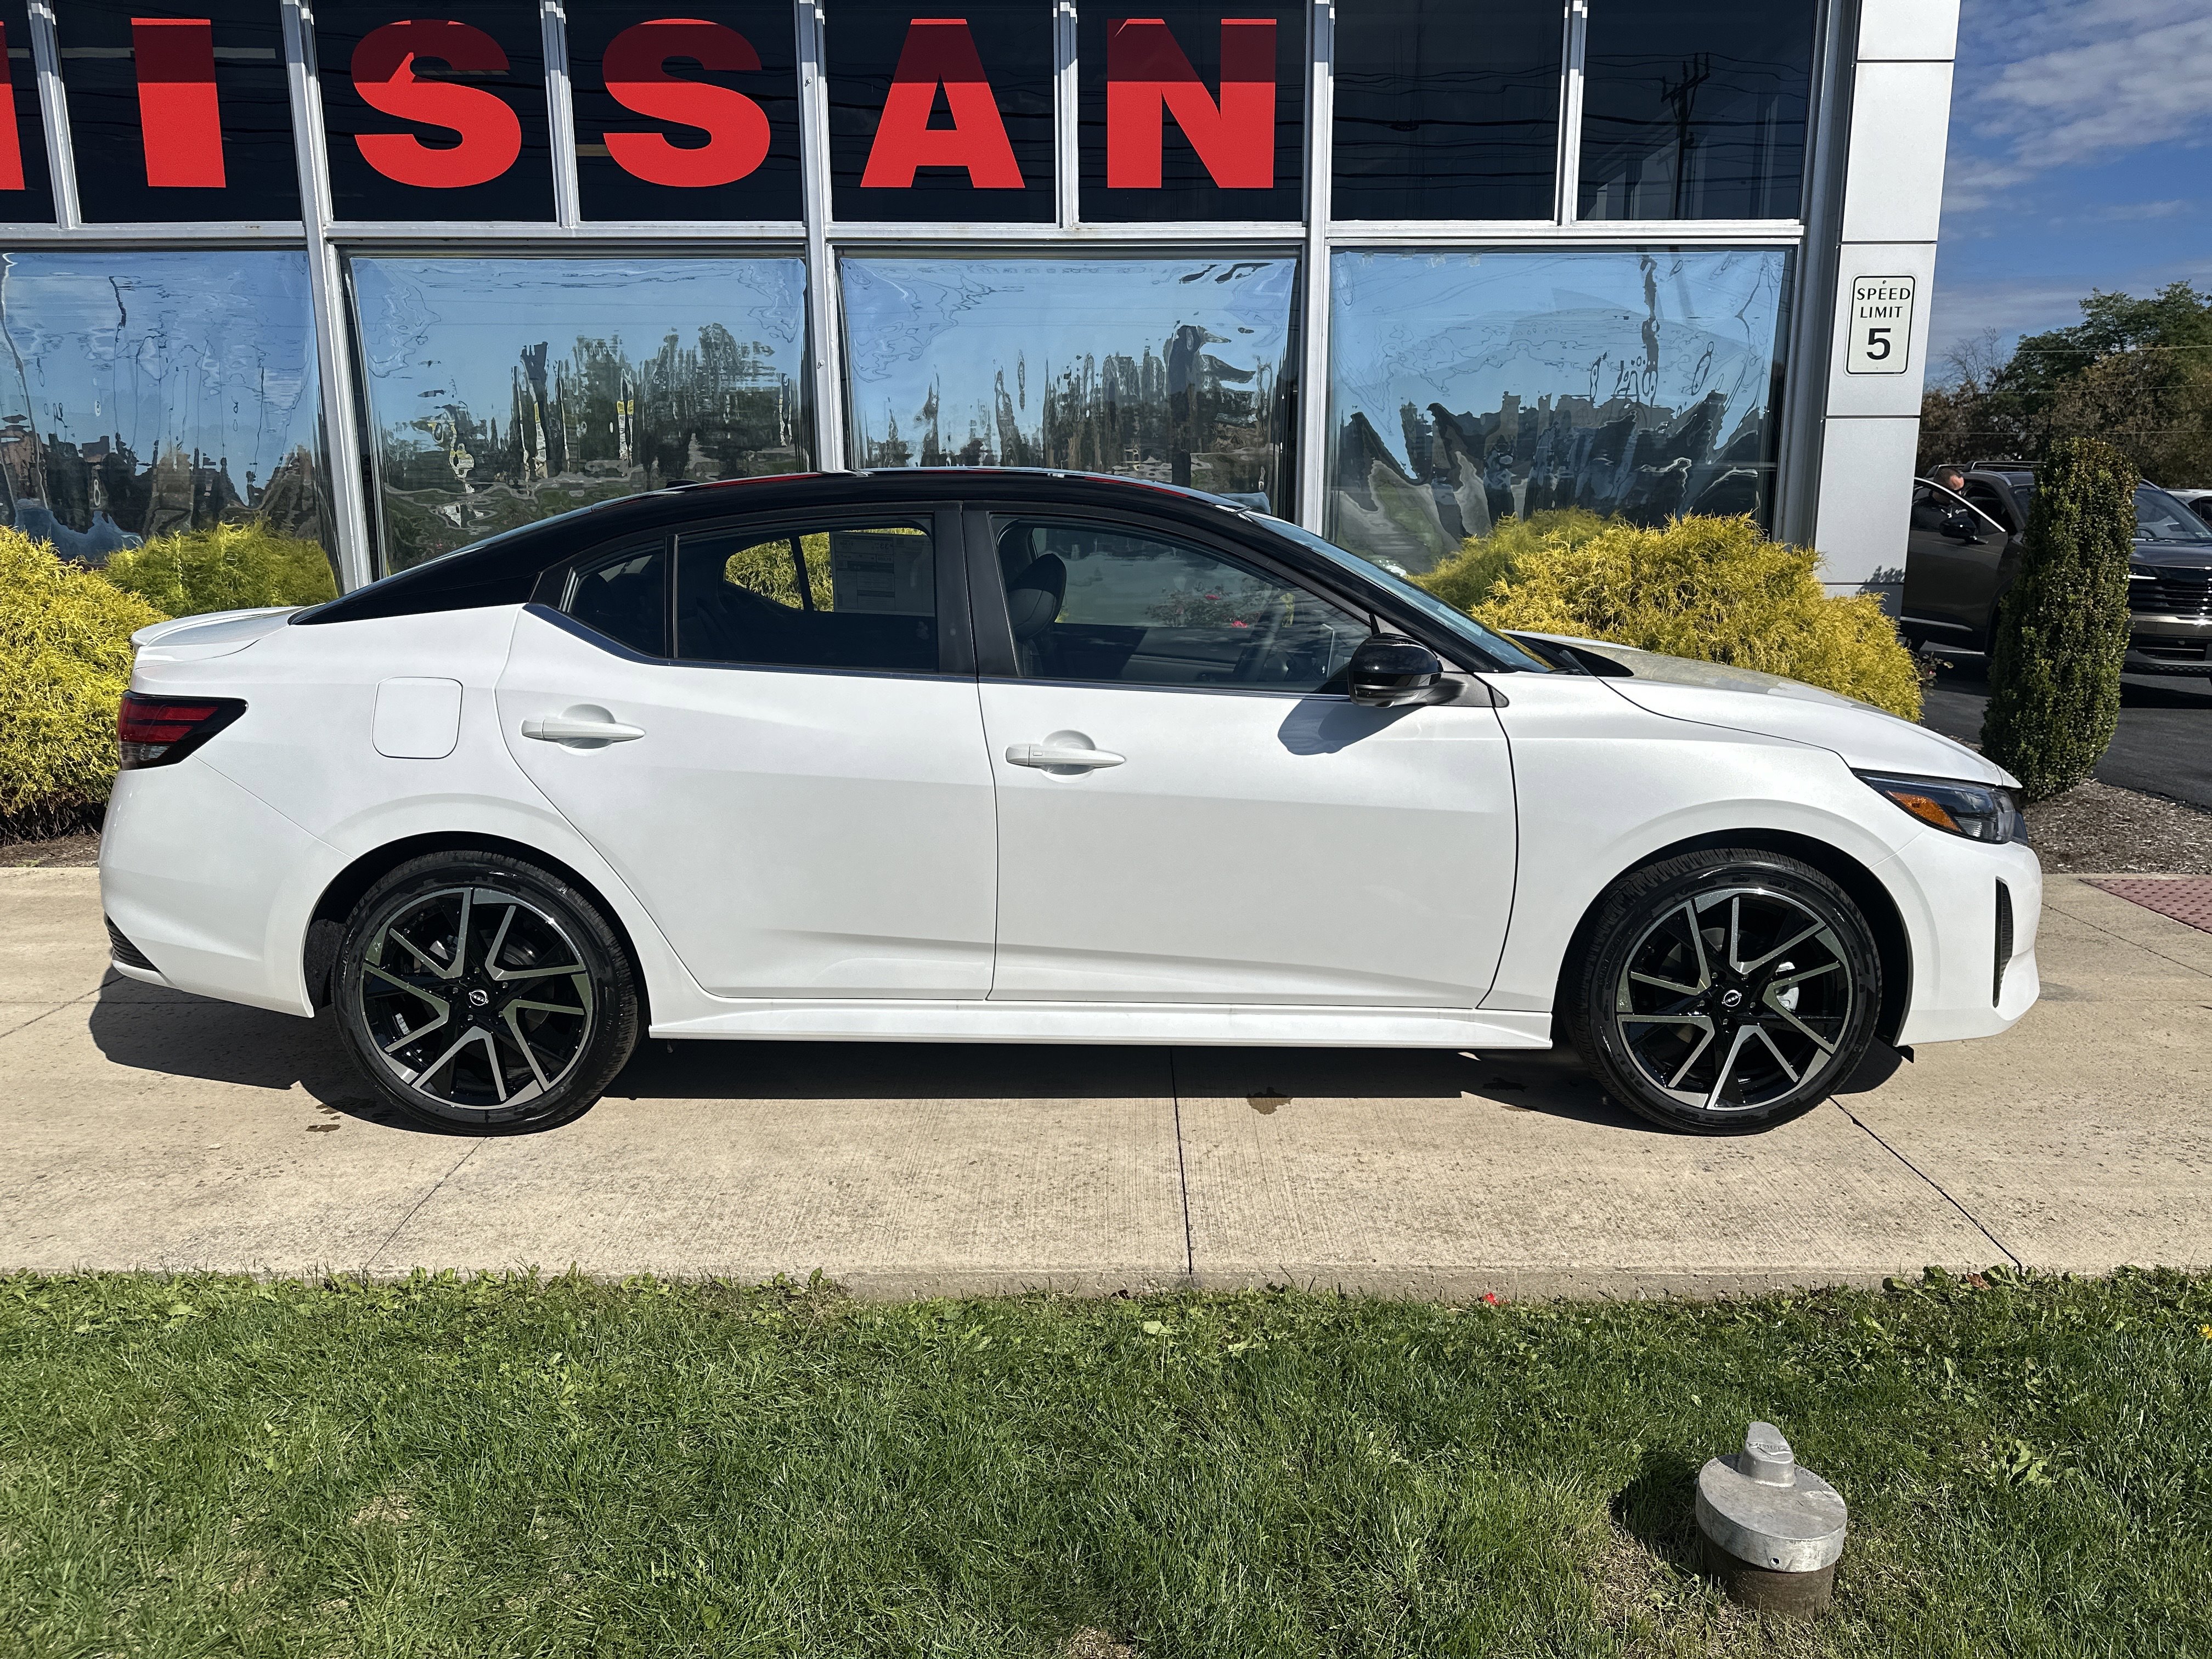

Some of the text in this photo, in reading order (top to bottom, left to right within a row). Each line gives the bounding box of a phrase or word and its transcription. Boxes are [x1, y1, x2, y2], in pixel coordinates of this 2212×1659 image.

[0, 18, 1277, 189] ISSAN
[1857, 288, 1911, 300] SPEED
[1860, 306, 1903, 318] LIMIT
[1866, 328, 1892, 360] 5
